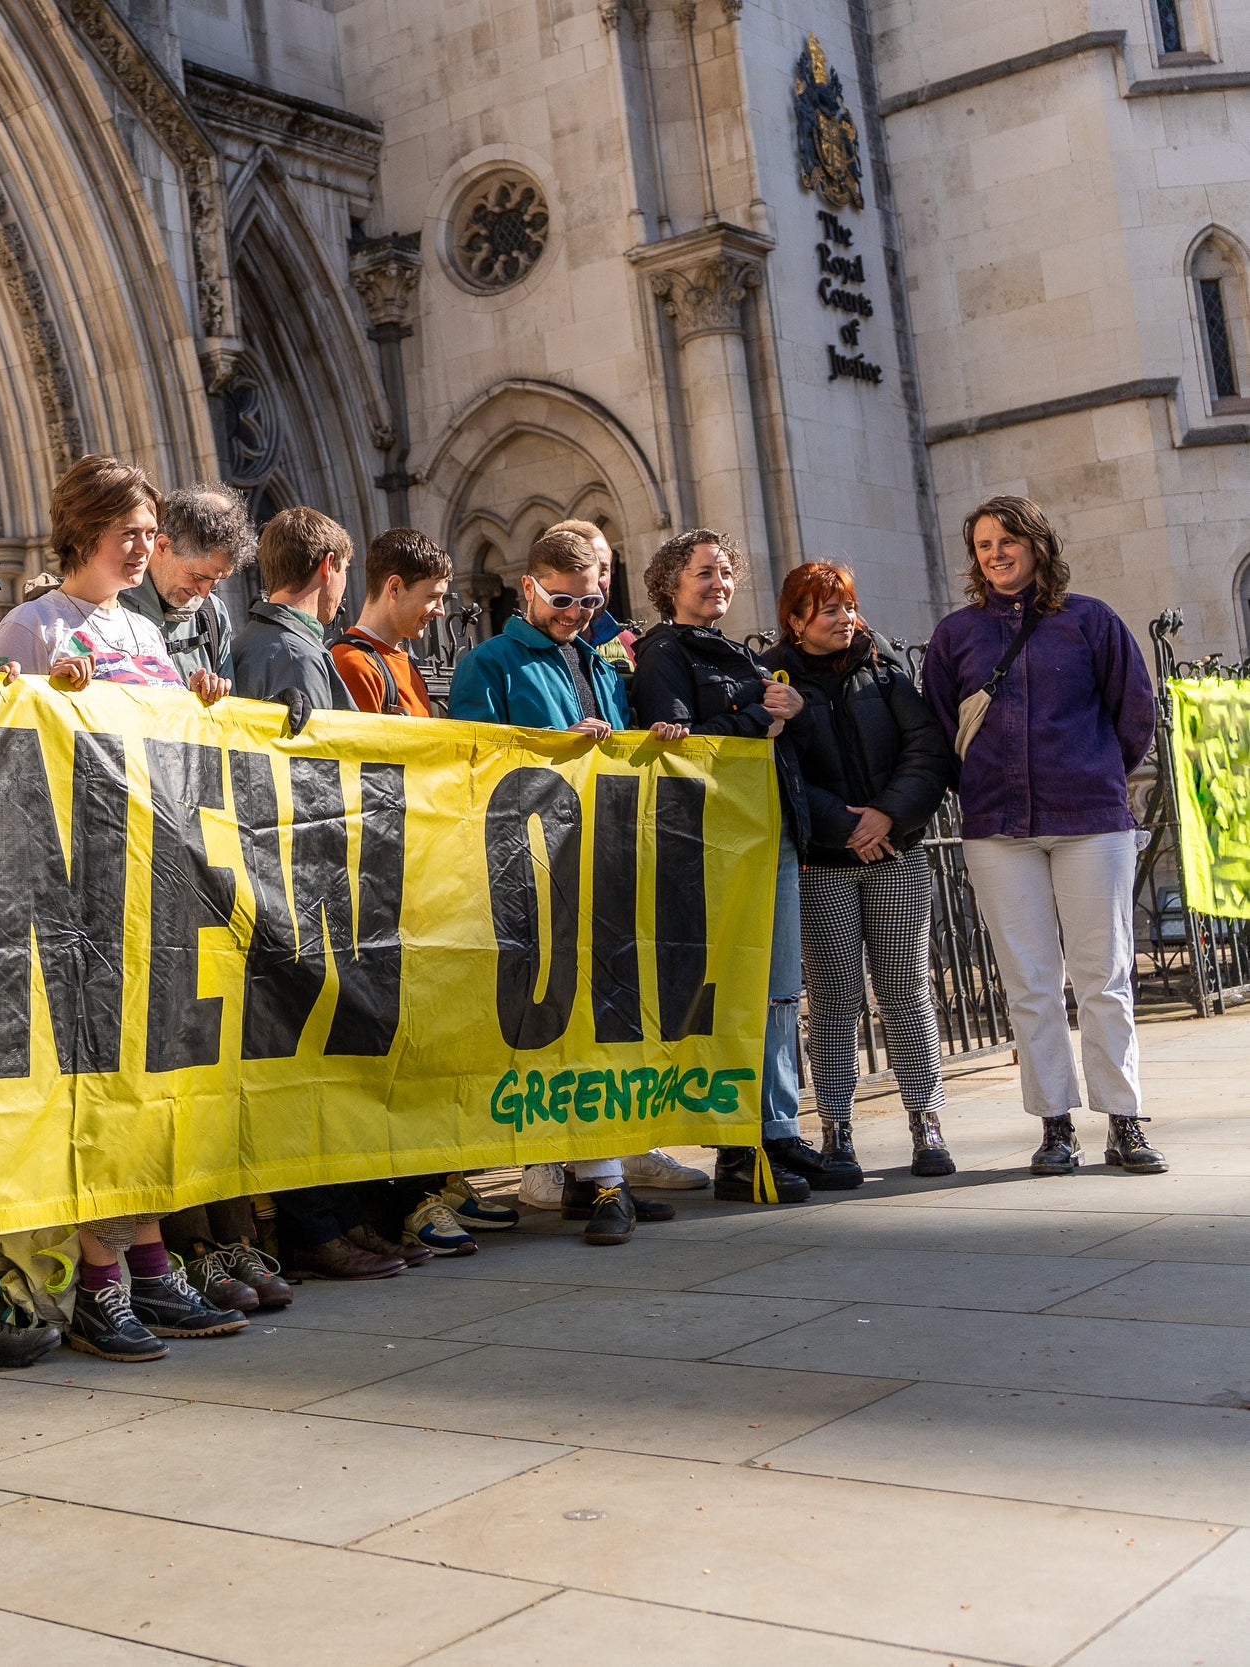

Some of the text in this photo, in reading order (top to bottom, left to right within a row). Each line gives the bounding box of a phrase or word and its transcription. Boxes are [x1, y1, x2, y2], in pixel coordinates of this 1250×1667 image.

[816, 210, 854, 247] The
[815, 242, 865, 285] Royal
[817, 277, 874, 317] Courts
[840, 318, 861, 346] of
[827, 344, 884, 384] Justice
[484, 766, 717, 1050] OIL
[490, 1065, 756, 1133] GREENPEACE
